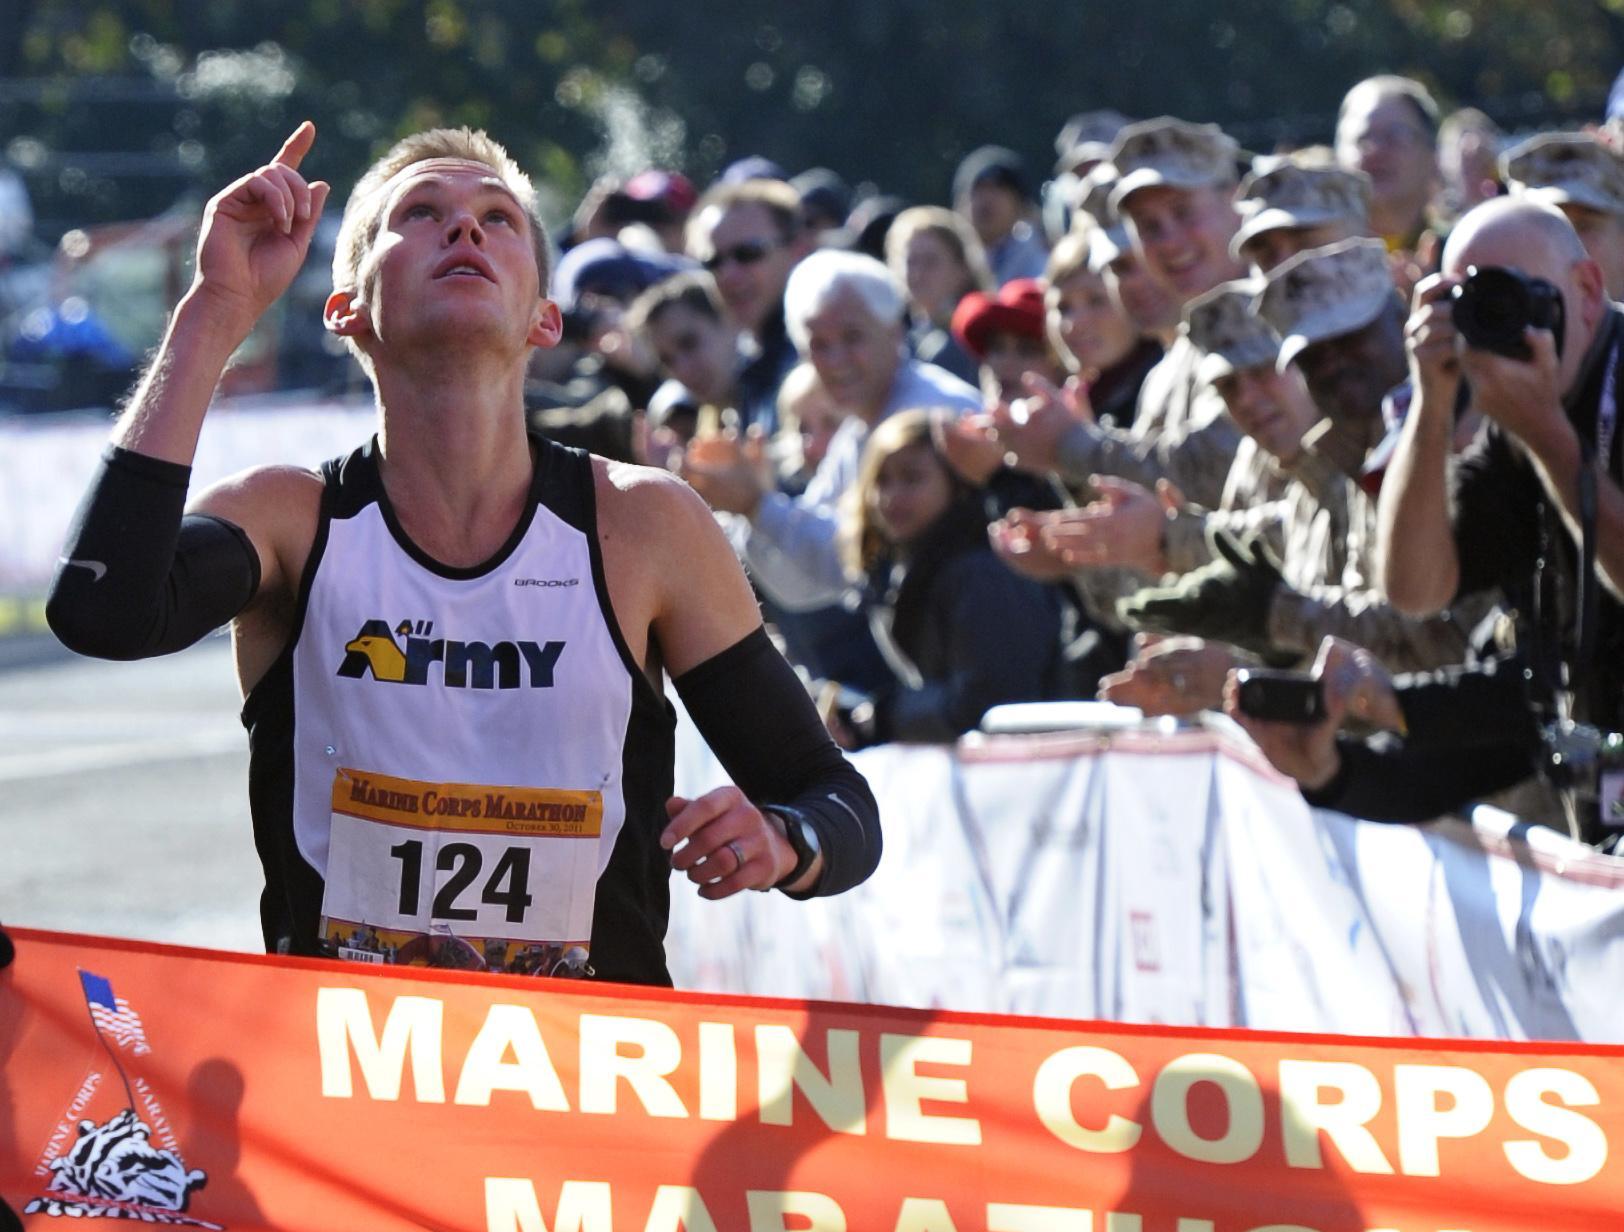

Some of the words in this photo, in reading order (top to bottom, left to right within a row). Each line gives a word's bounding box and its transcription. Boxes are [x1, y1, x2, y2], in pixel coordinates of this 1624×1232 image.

[514, 578, 579, 587] BROOKS
[351, 777, 419, 814] MARINE
[421, 790, 482, 818] CORPS
[484, 792, 588, 822] MARATHON
[563, 824, 583, 833] 2011
[390, 839, 533, 924] 124
[66, 1072, 102, 1122] CORPS
[315, 986, 982, 1145] MARINE
[1032, 1045, 1609, 1185] CORPS
[135, 1076, 187, 1167] MARATH
